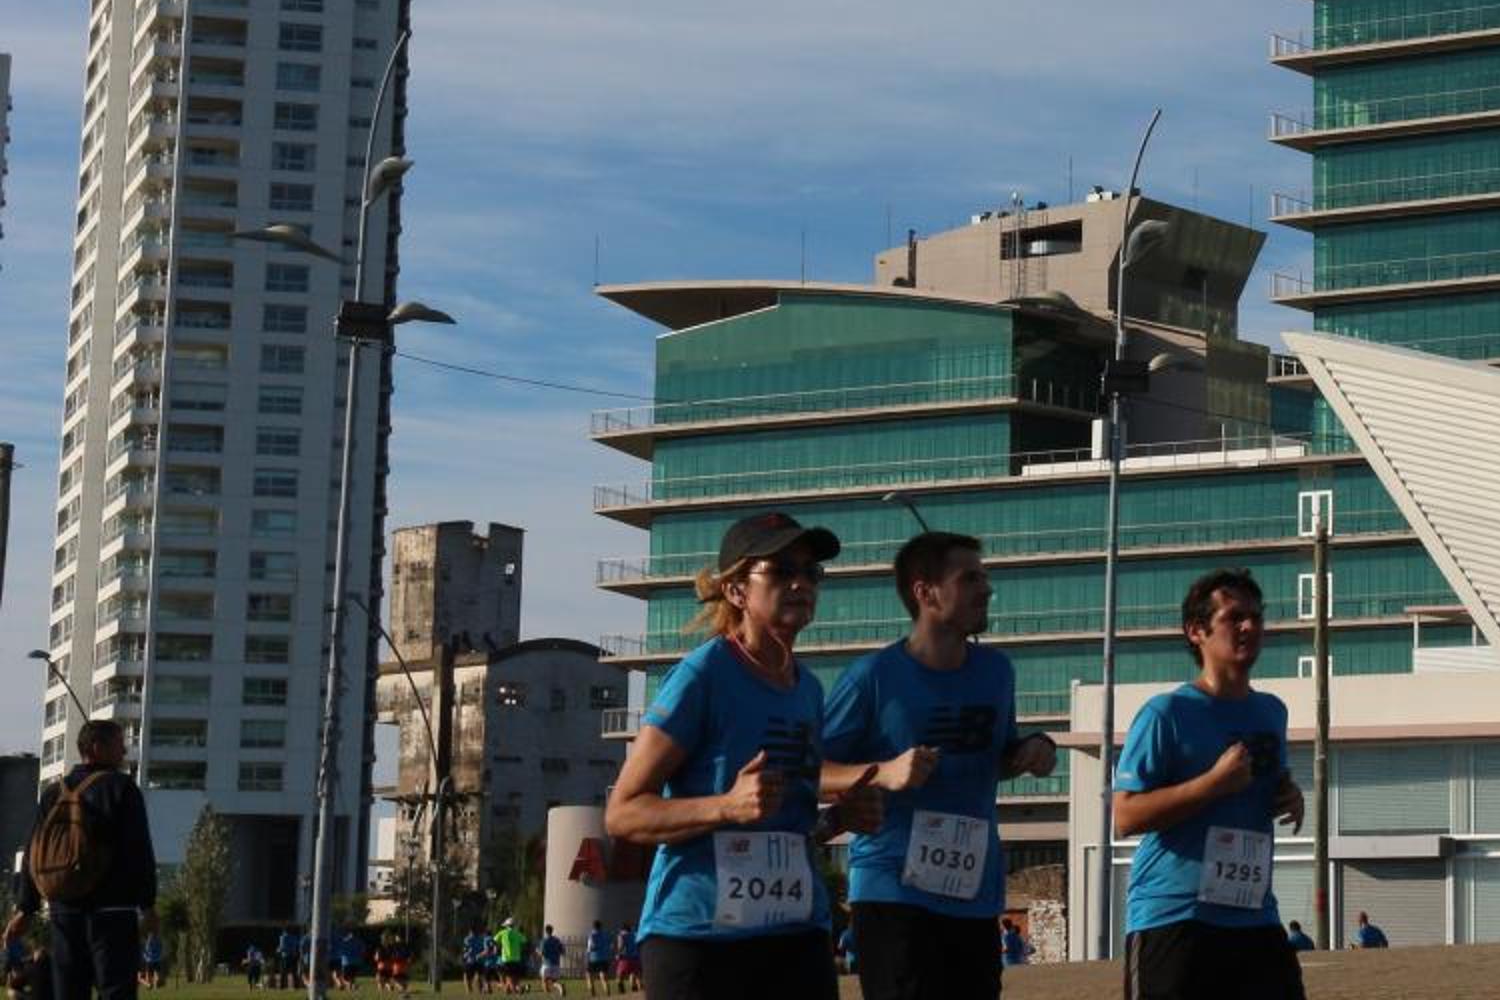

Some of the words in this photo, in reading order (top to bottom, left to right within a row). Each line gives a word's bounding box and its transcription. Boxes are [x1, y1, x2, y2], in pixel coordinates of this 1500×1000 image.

[919, 845, 976, 871] 1030
[1215, 860, 1263, 883] 1295
[728, 877, 803, 901] 2044
